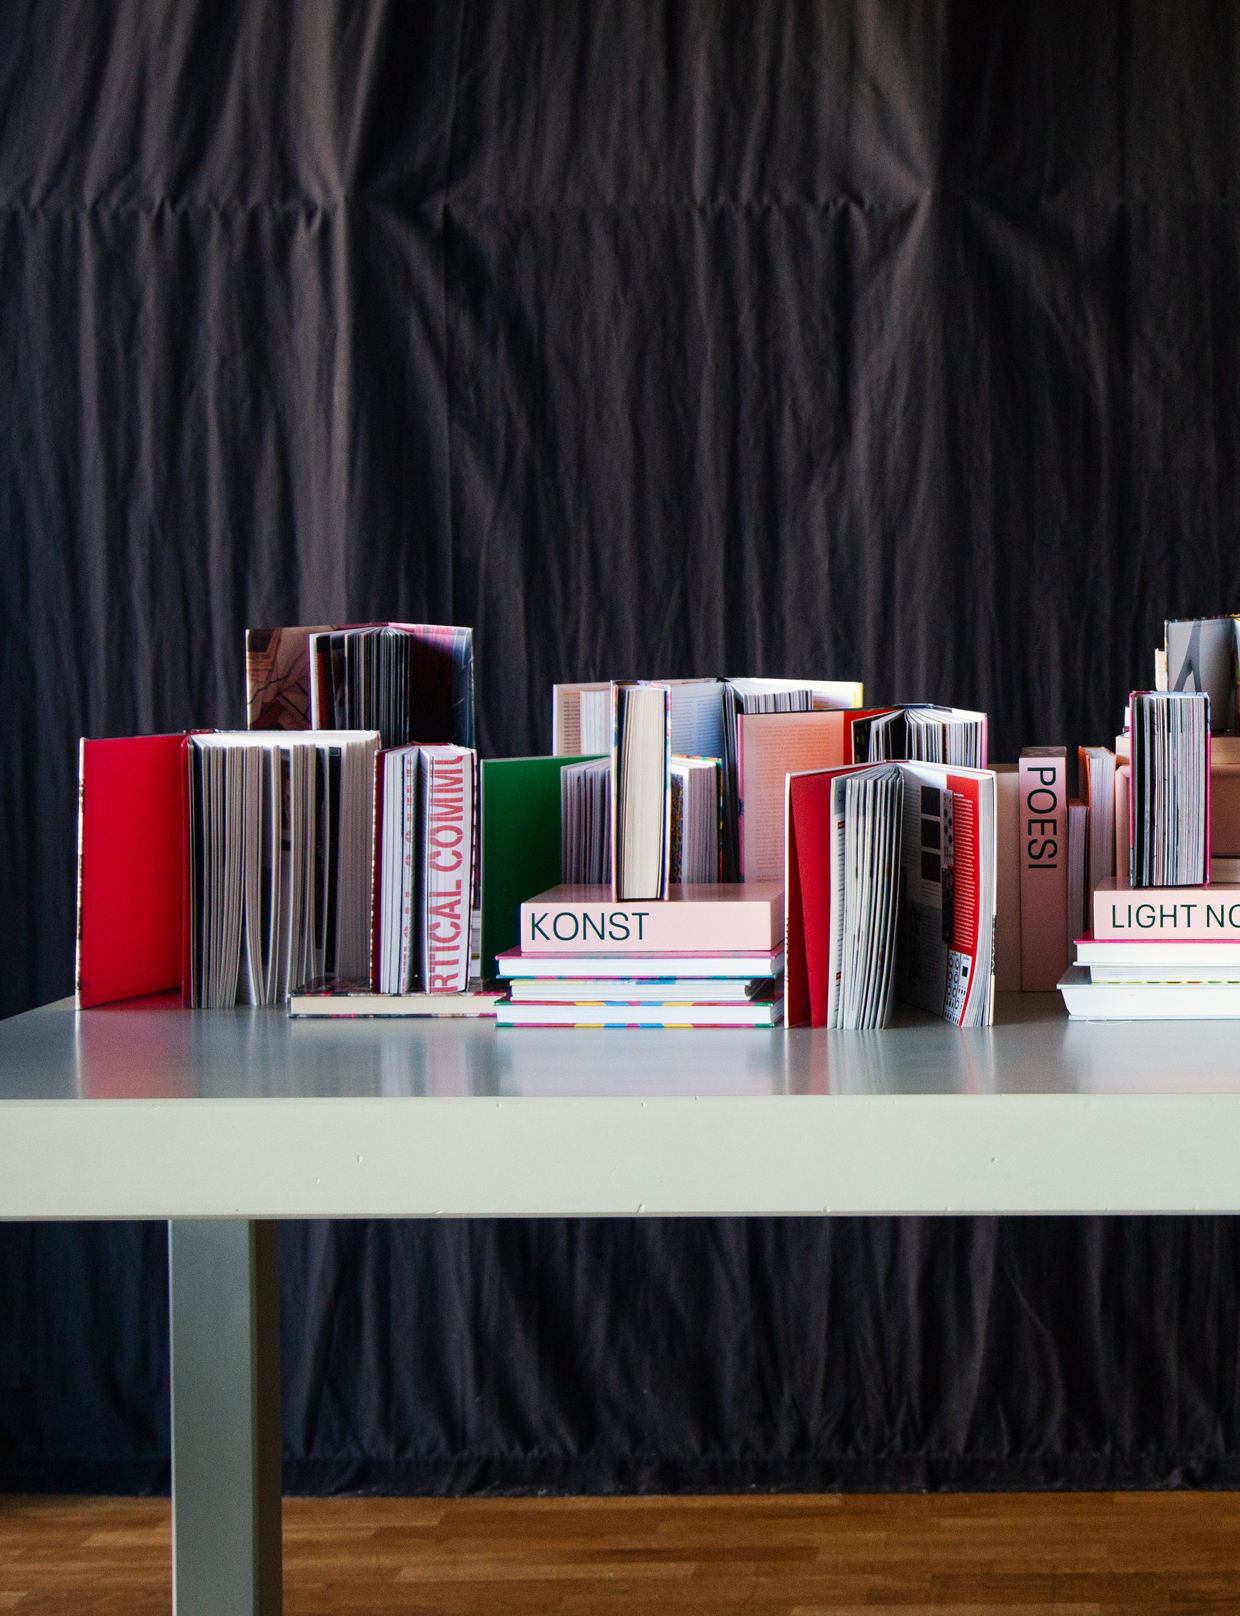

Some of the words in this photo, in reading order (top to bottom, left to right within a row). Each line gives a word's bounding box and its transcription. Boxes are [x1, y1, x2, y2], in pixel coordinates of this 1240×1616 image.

[1027, 766, 1058, 869] POESI
[531, 911, 650, 941] KONST
[1112, 903, 1197, 929] LIGHT
